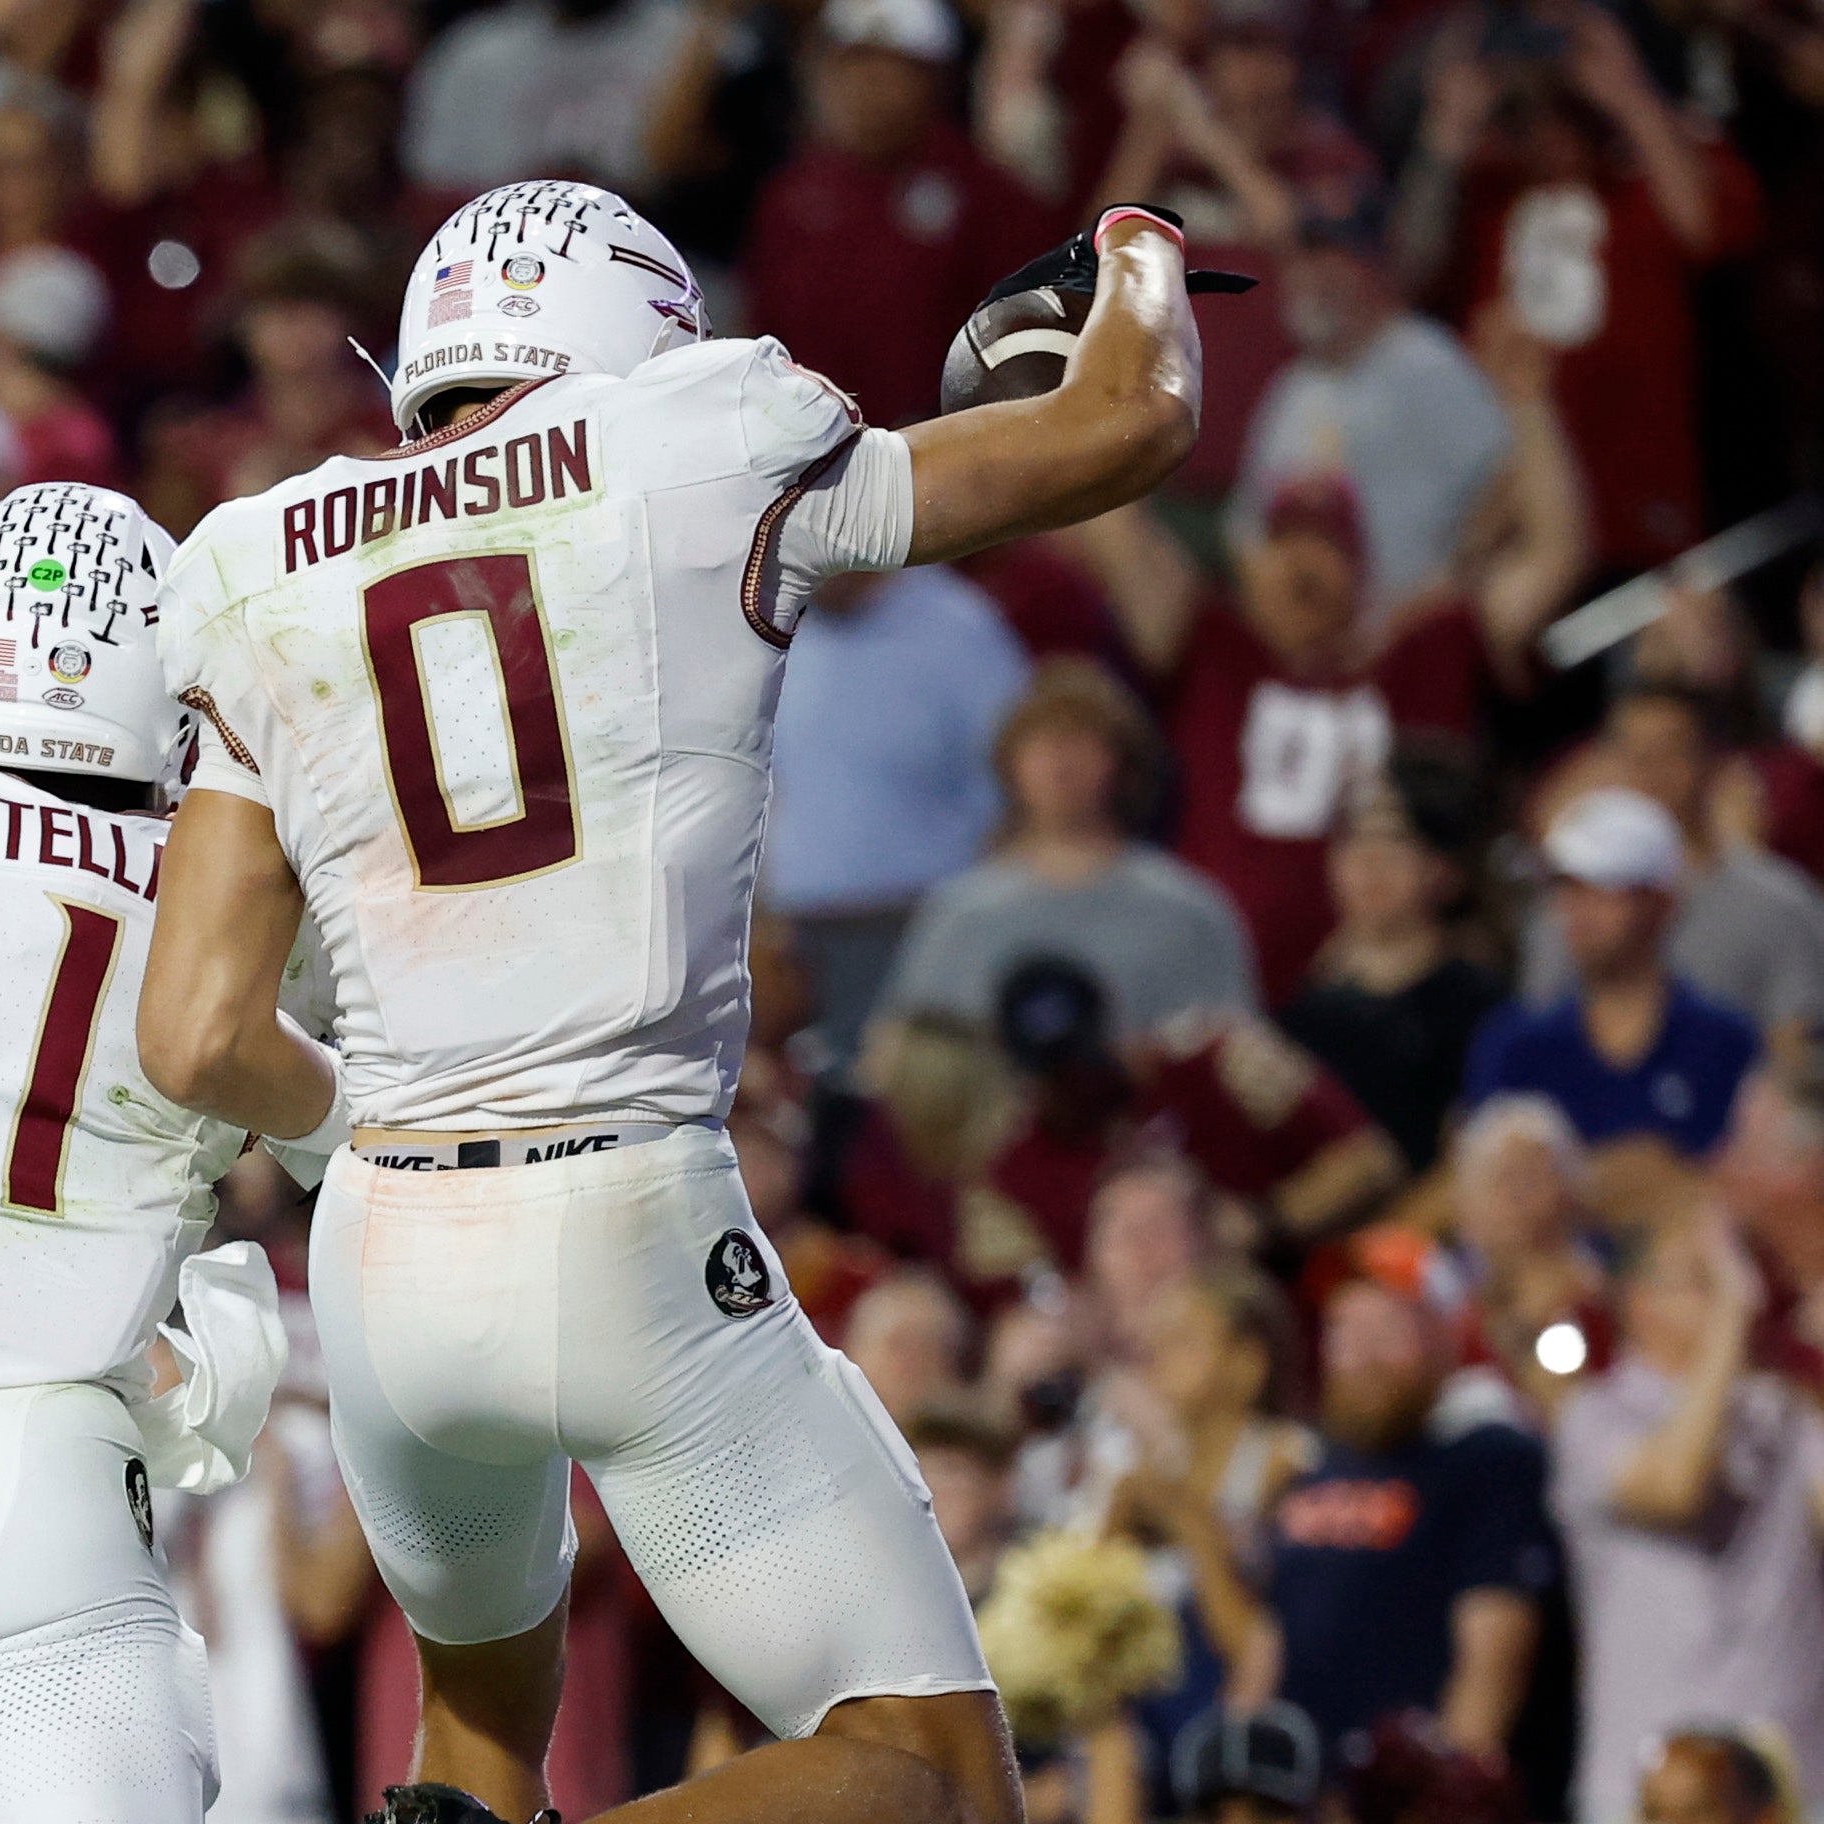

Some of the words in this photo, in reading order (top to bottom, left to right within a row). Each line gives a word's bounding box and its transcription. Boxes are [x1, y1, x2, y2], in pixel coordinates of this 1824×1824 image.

[504, 300, 533, 311] ACC
[404, 342, 483, 384] FLORIDA
[494, 342, 571, 374] STATE
[284, 418, 593, 575] ROBINSON
[30, 566, 64, 582] C2P
[49, 692, 79, 704] ACC
[356, 547, 584, 893] 0
[40, 738, 116, 767] STATE
[2, 890, 127, 1219] 1
